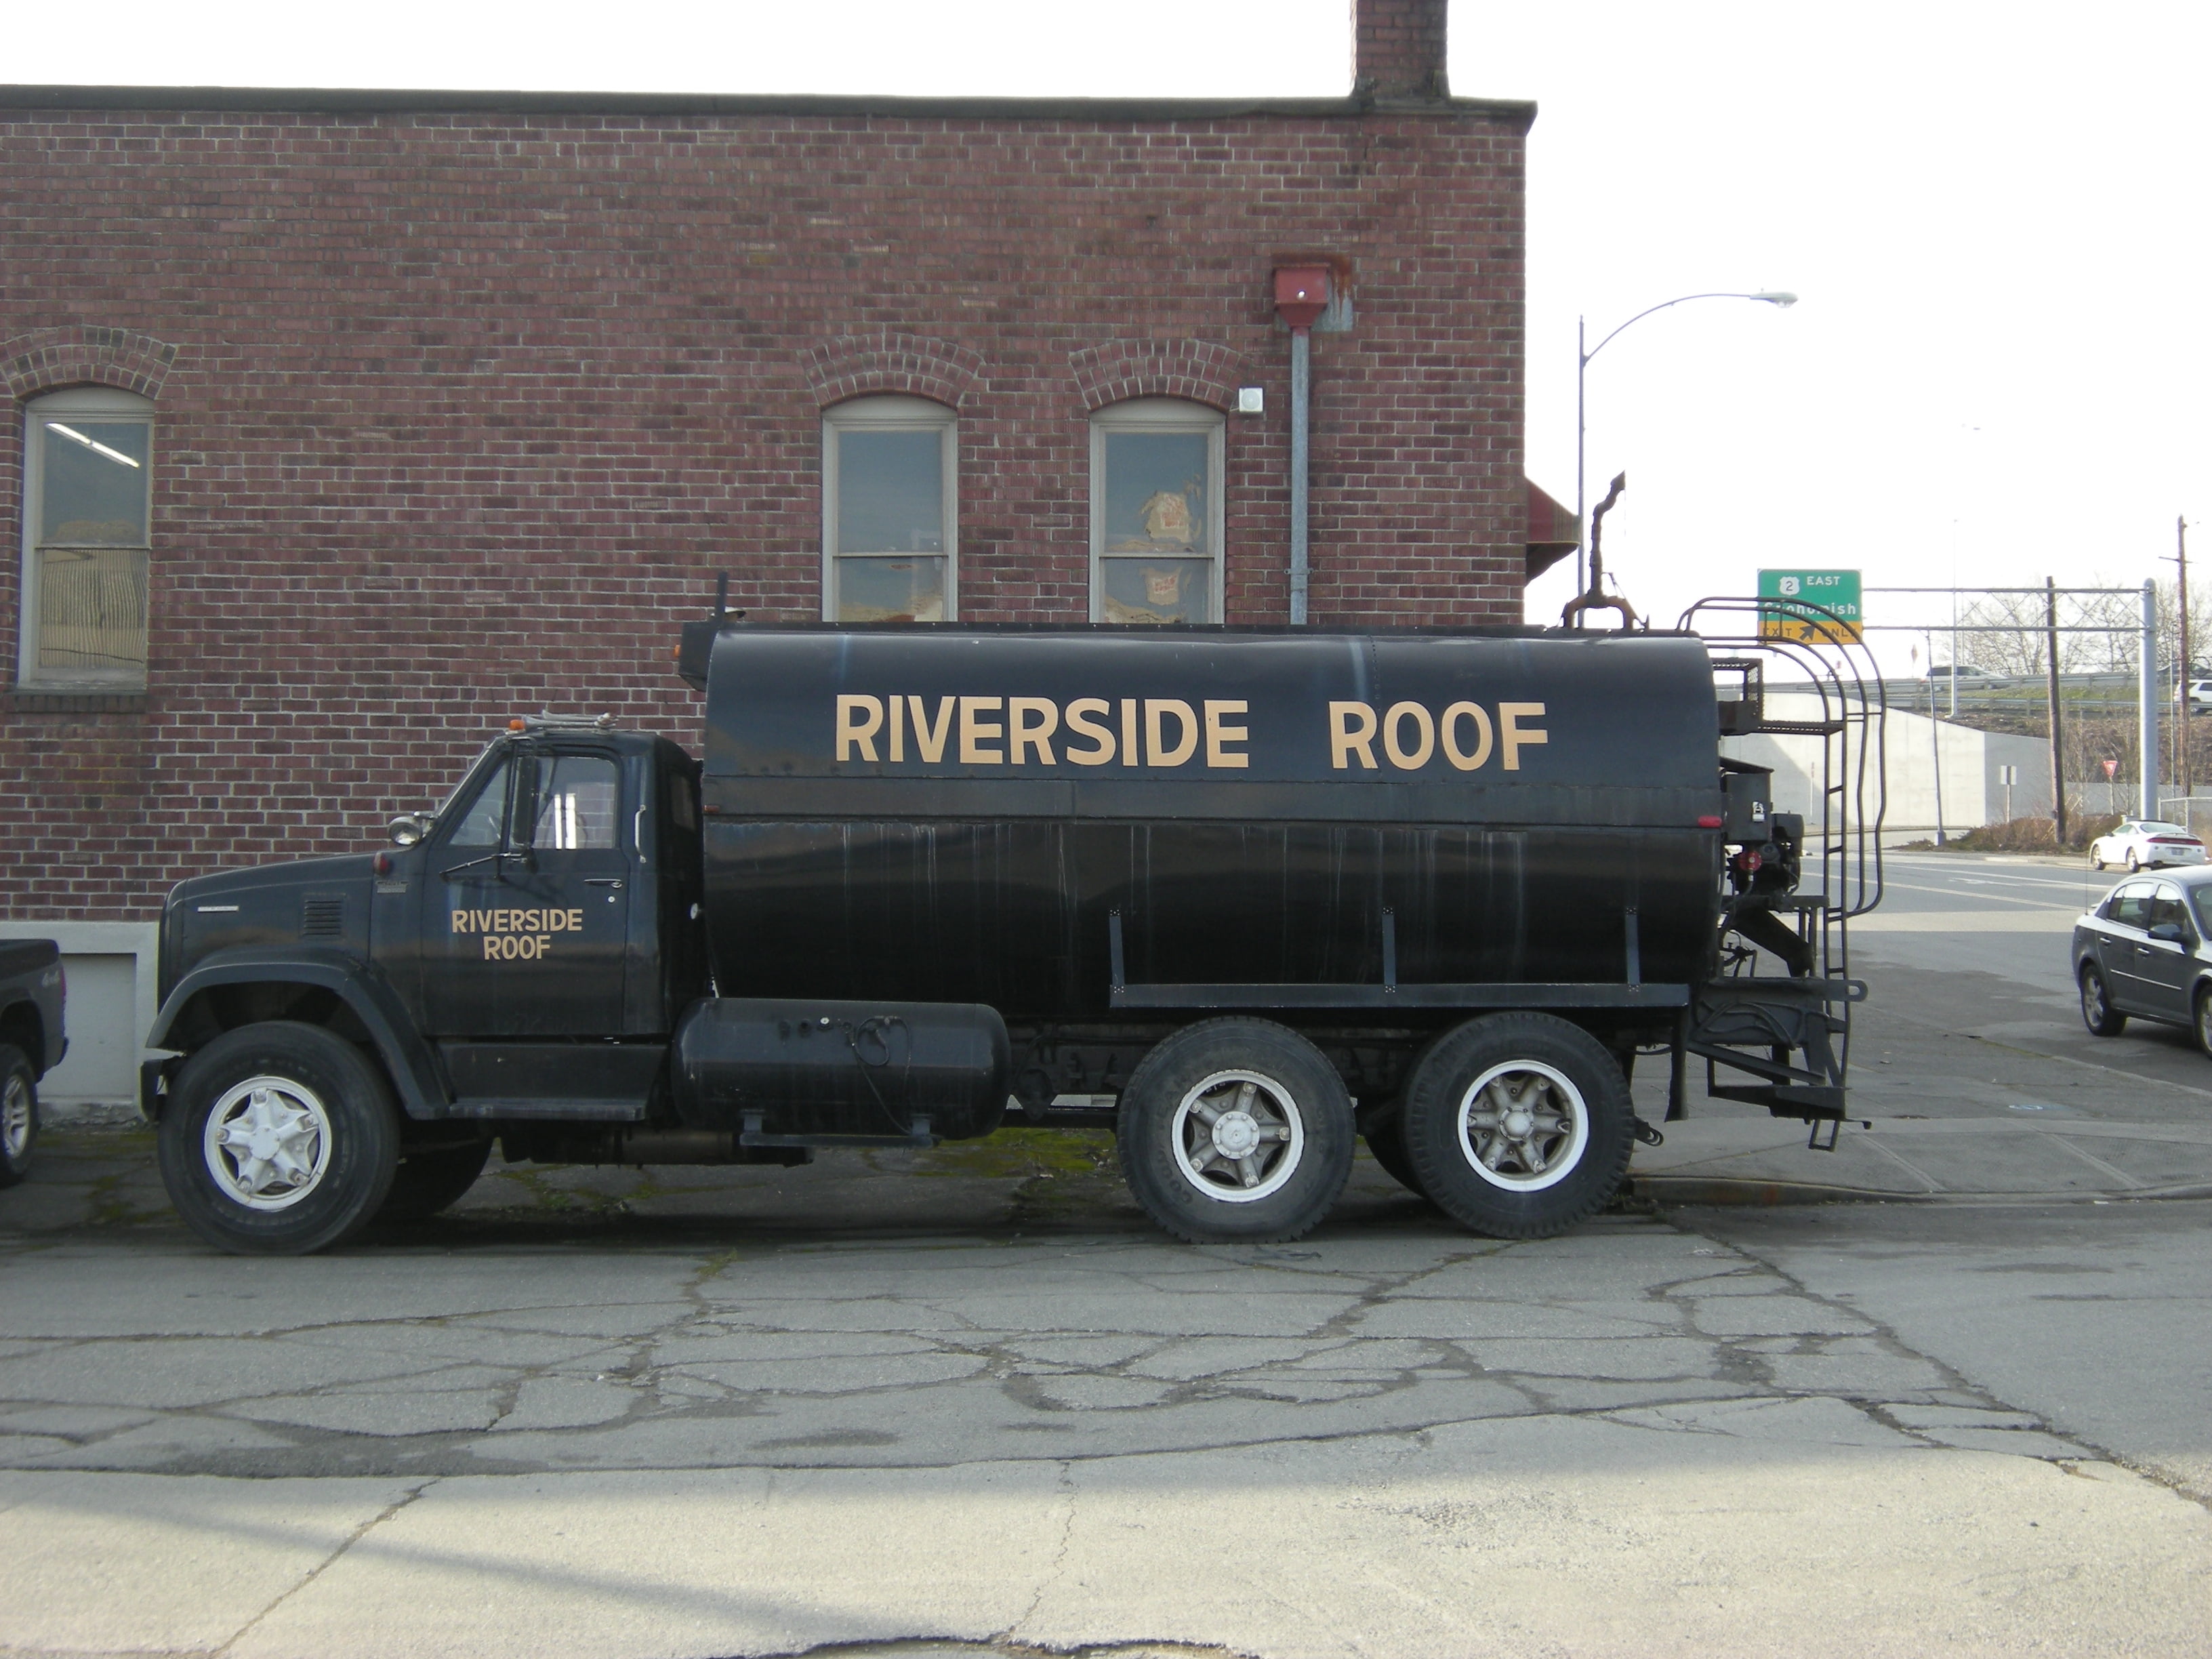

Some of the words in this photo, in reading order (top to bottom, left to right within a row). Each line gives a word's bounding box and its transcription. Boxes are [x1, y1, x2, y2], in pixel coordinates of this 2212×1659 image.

[1786, 581, 1794, 591] 2
[1806, 576, 1841, 586] EAST
[836, 695, 1248, 768] RIVERSIDE
[1328, 701, 1549, 771] ROOF
[451, 909, 583, 933] RIVERSIDE
[483, 935, 550, 960] ROOF
